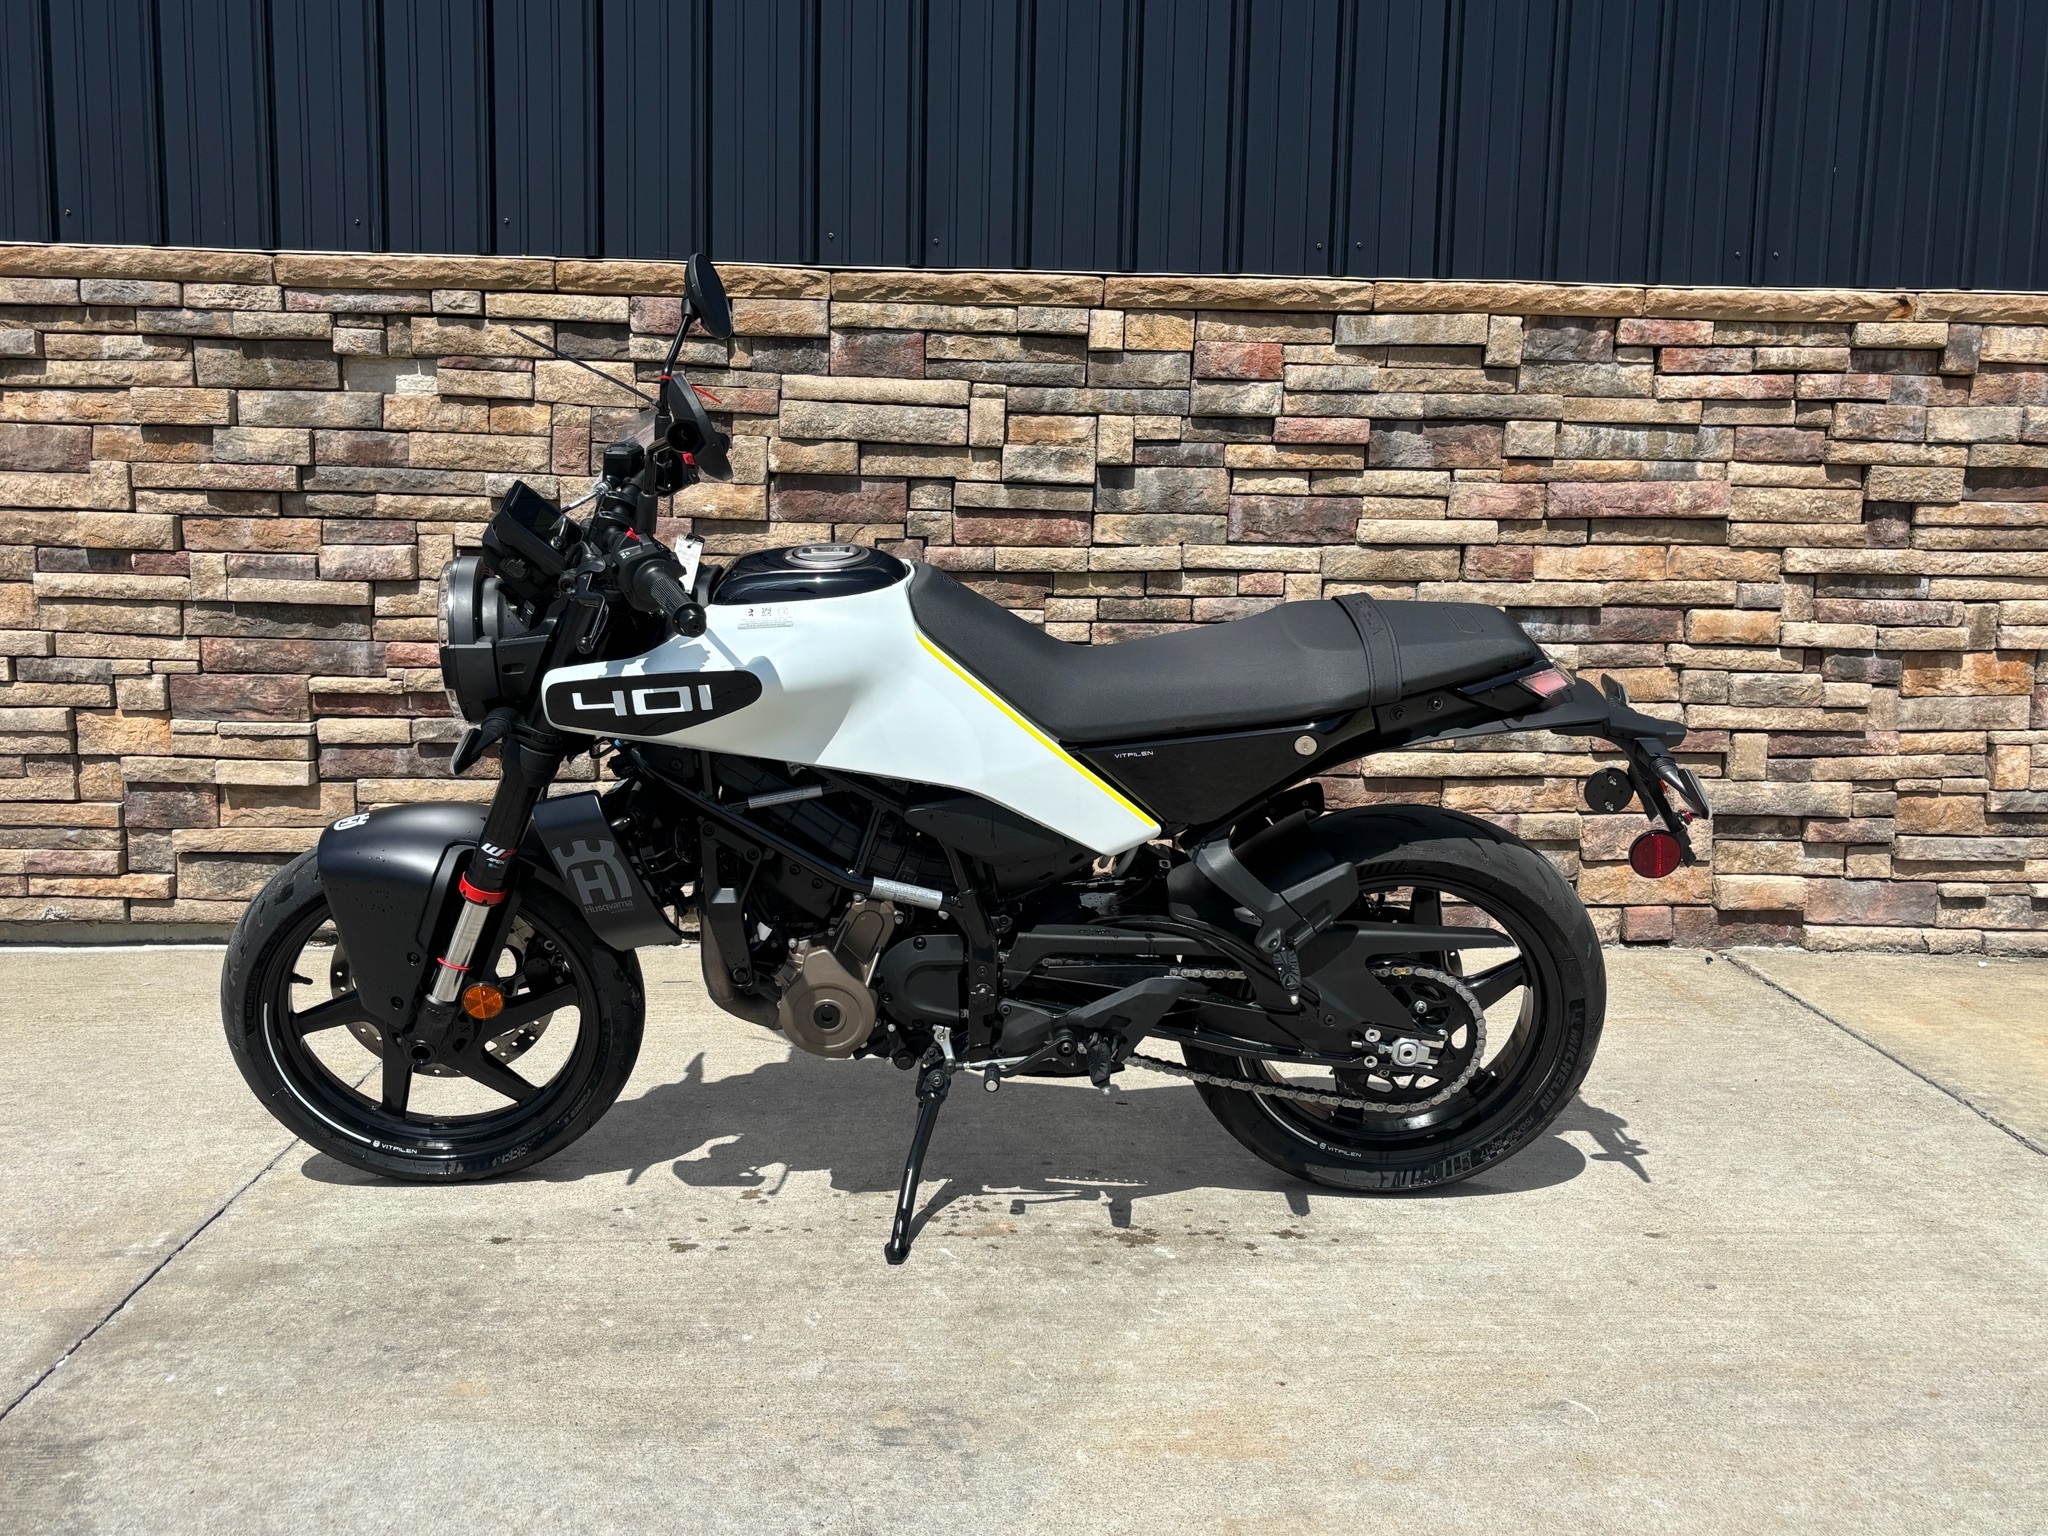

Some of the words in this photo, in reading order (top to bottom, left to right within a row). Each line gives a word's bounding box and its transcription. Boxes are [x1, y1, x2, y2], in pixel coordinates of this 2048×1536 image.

[572, 684, 713, 717] 401
[1114, 750, 1154, 759] VITPILEN
[584, 899, 633, 914] Husqvarna
[1538, 1027, 1581, 1112] MICHELIN
[381, 1143, 418, 1155] VITPILEN
[1328, 1146, 1362, 1157] VITPILEN
